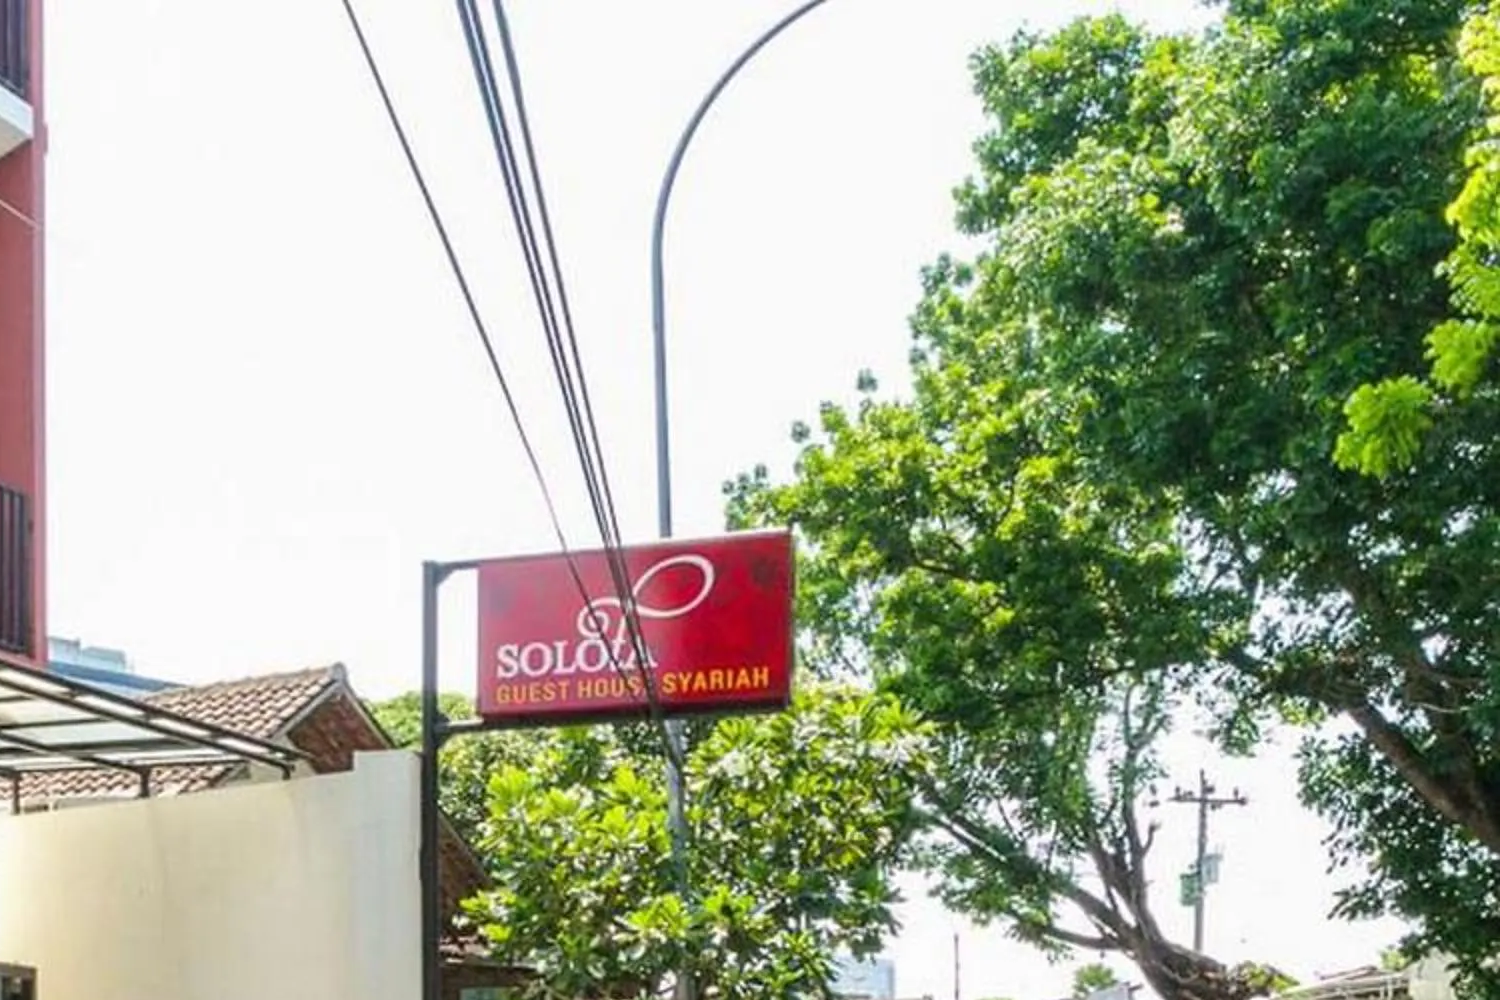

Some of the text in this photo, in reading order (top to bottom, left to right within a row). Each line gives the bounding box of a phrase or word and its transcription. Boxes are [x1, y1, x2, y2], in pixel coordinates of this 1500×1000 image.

[497, 667, 769, 704] GUEST HOUS SYARIAH
